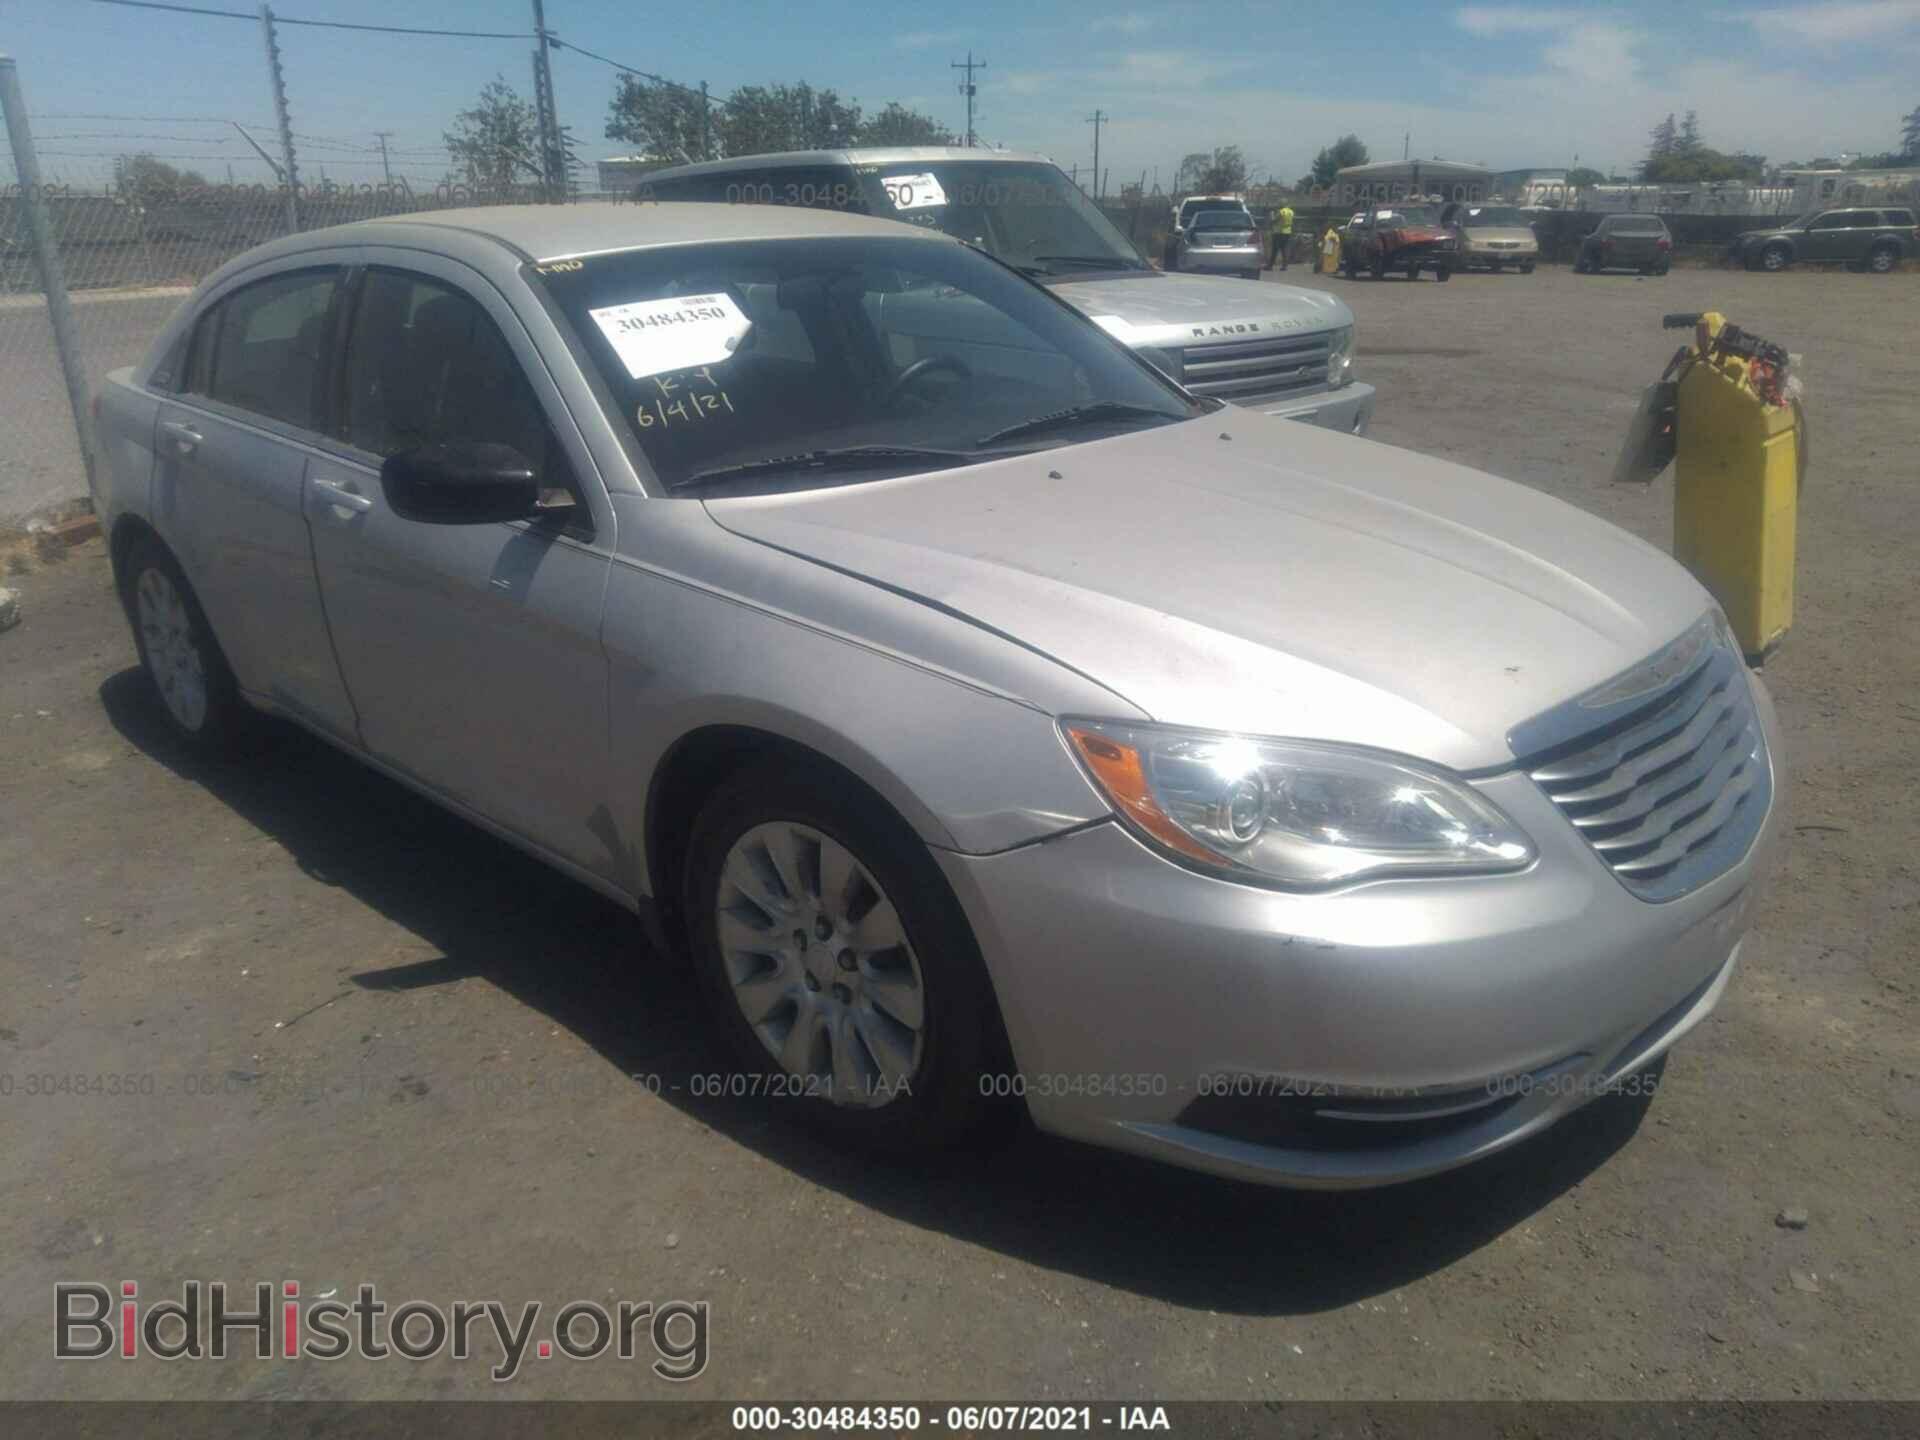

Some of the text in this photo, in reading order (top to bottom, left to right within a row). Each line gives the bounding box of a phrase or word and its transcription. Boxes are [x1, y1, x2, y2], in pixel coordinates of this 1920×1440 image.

[616, 306, 726, 333] 30484350
[1191, 323, 1260, 337] RANGE
[637, 392, 735, 428] 6/4/21
